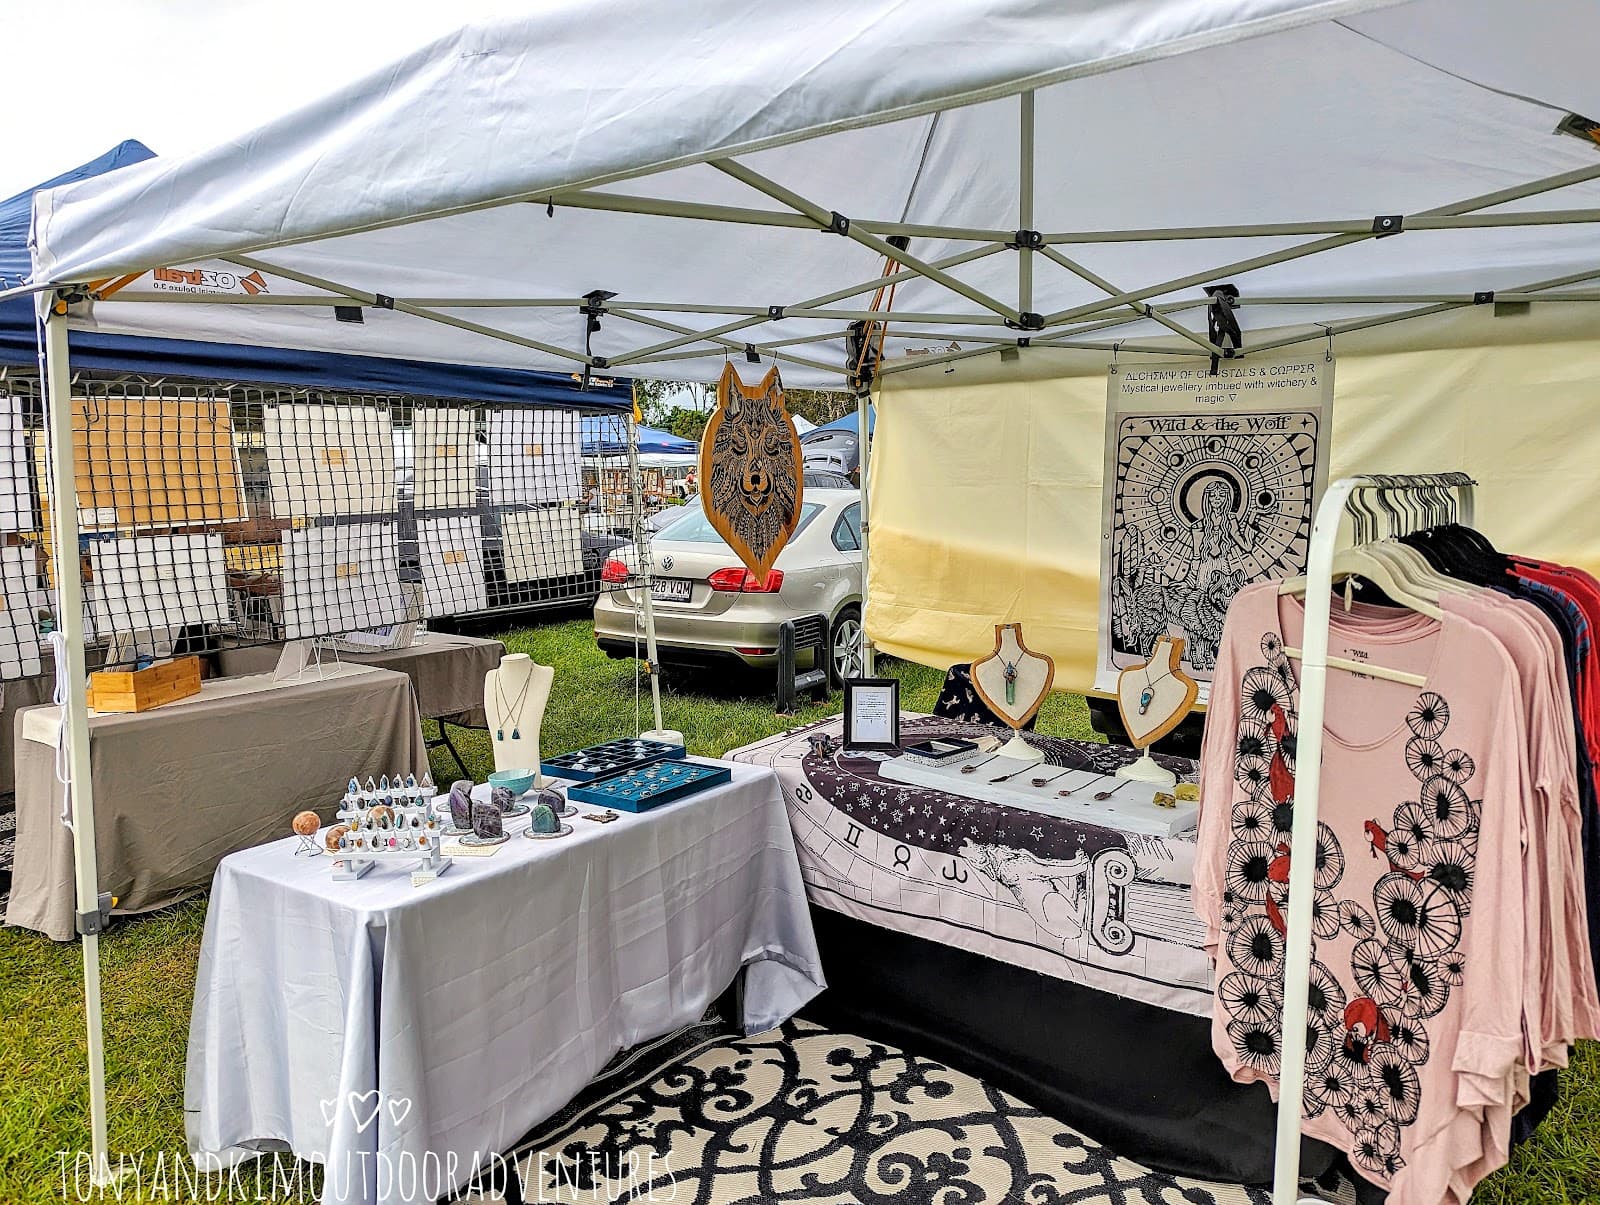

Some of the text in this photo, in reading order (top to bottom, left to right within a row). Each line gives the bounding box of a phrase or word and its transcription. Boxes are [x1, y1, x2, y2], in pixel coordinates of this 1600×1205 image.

[1259, 367, 1266, 376] &
[1121, 376, 1317, 395] Mystical jewellery imbued with witchery &
[1195, 394, 1225, 405] magic
[1143, 416, 1291, 434] Wild & the Wolf
